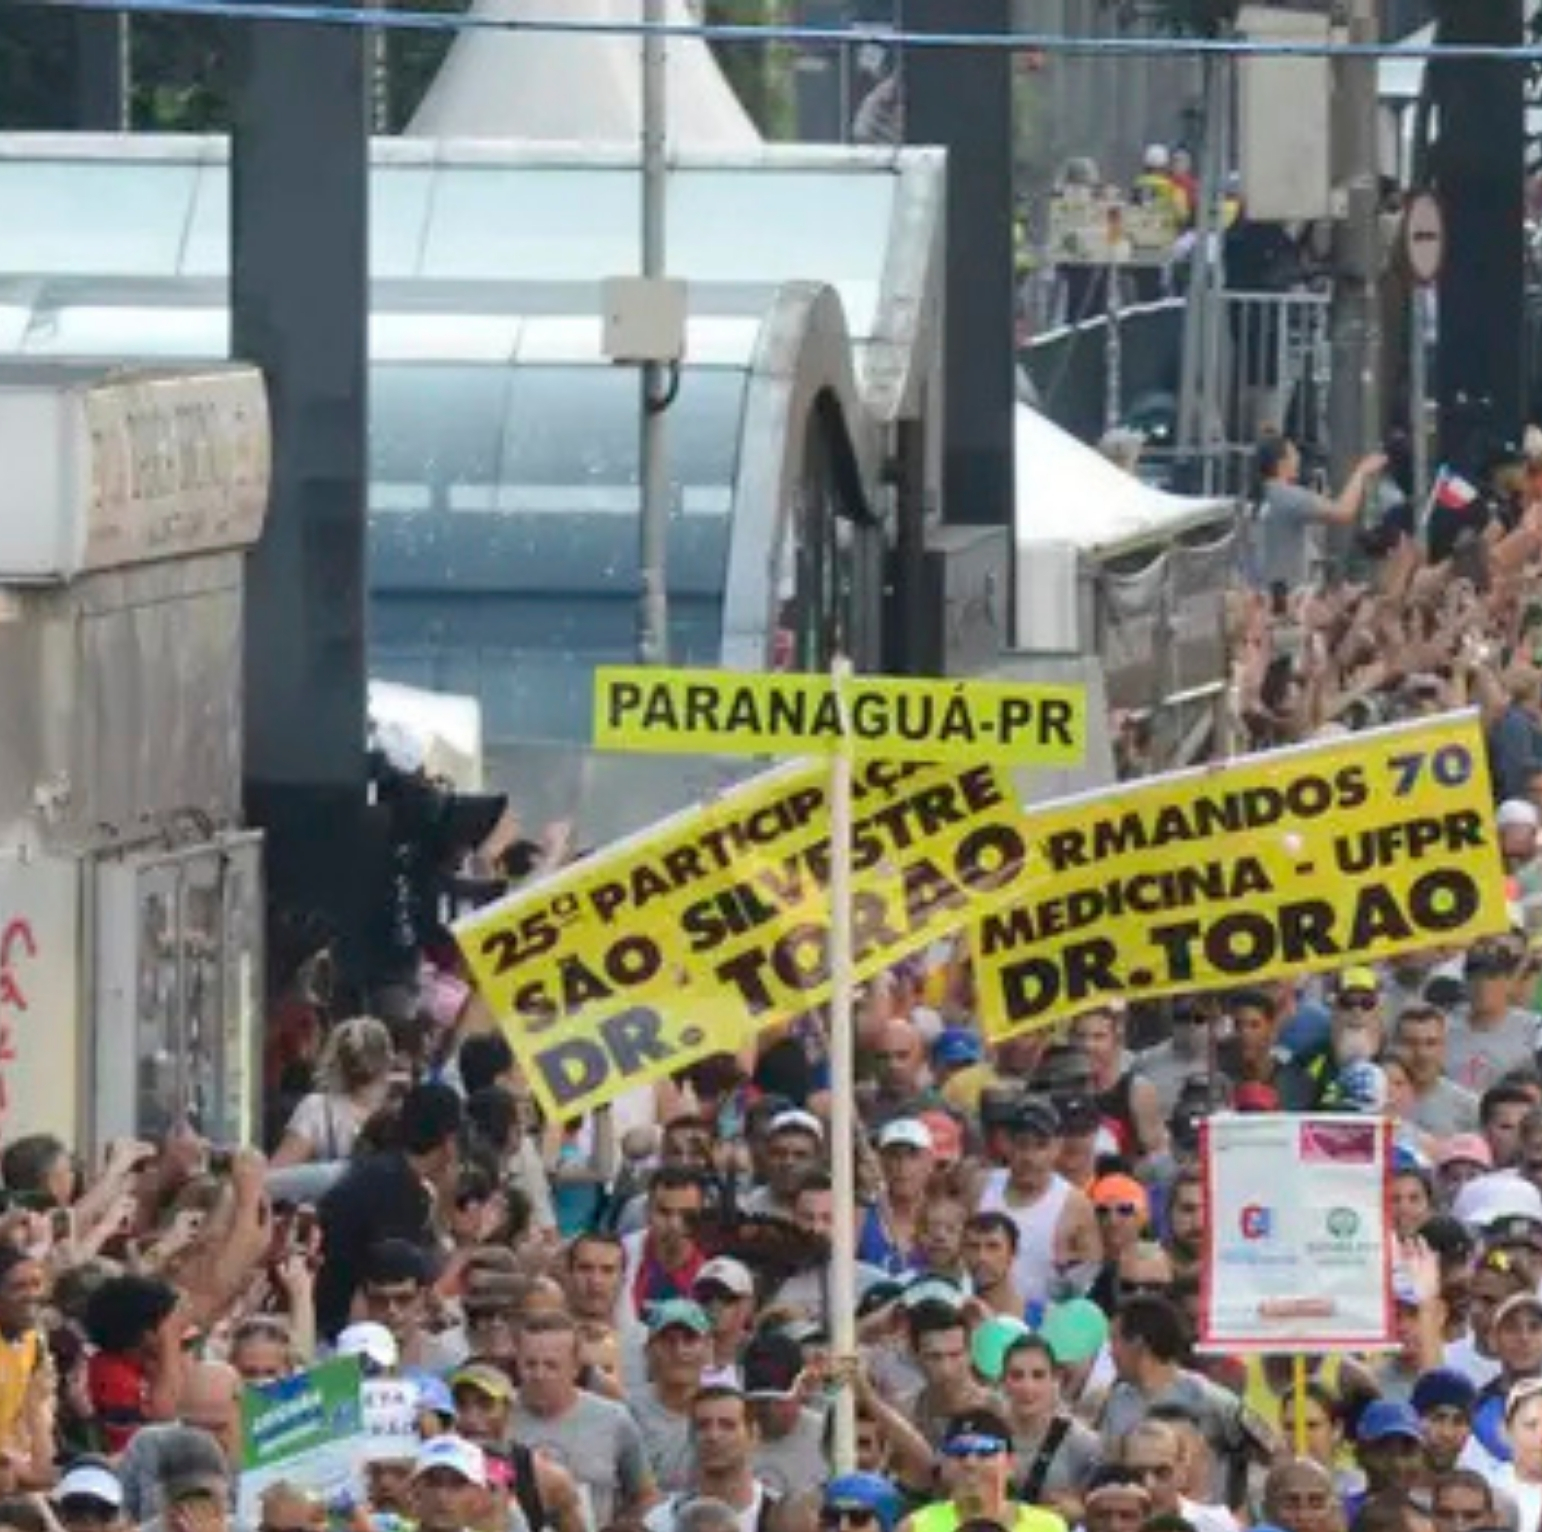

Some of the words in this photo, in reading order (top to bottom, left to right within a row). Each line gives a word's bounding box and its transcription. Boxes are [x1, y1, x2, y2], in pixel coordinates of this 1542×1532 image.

[607, 680, 1074, 745] PARANAGUÁ-PR
[1387, 744, 1473, 798] 70
[980, 854, 1275, 955] MEDICINA
[1333, 808, 1487, 879] UFPR
[532, 1005, 706, 1106] DR.
